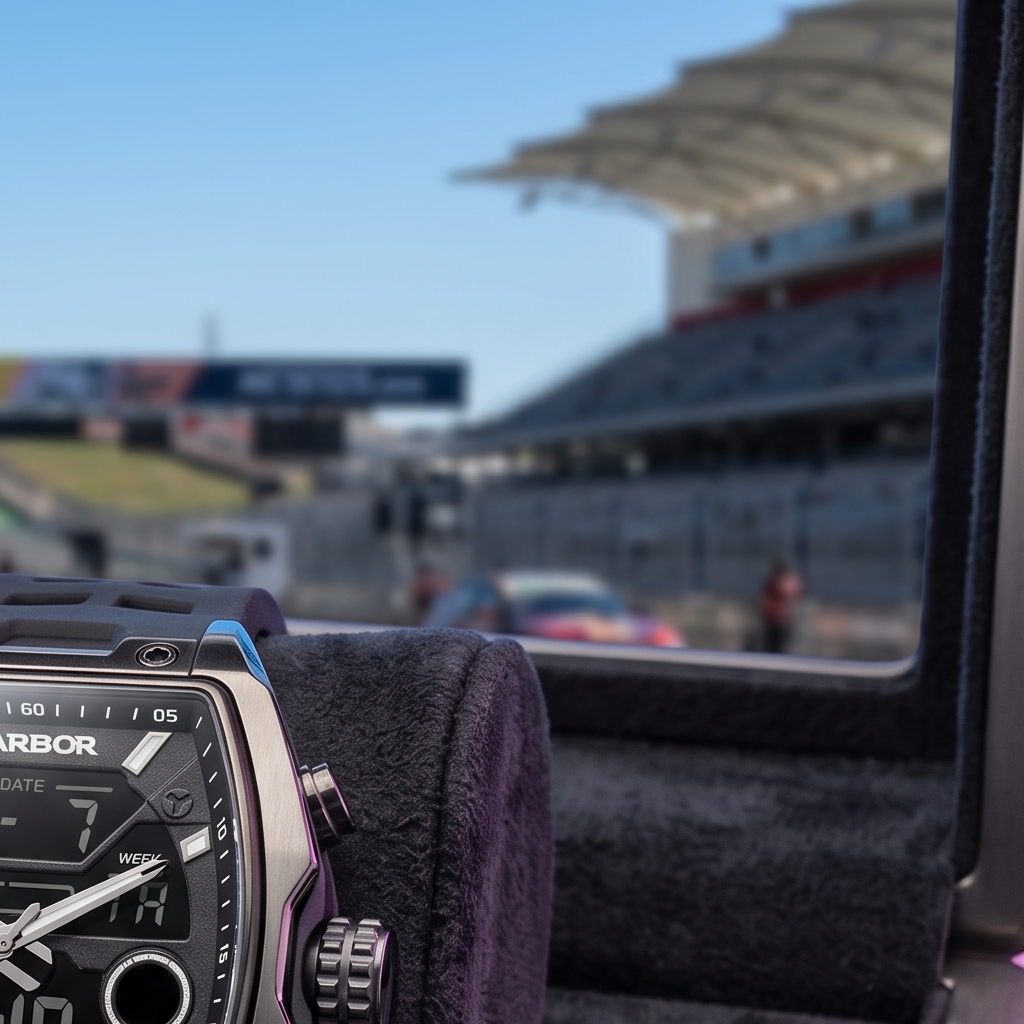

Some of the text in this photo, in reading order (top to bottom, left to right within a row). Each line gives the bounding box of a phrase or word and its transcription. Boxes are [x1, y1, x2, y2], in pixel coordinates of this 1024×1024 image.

[20, 702, 45, 717] 60
[153, 708, 178, 723] 05
[0, 777, 45, 793] DATE
[68, 798, 98, 852] 7
[216, 817, 228, 841] 10
[217, 943, 230, 965] 15
